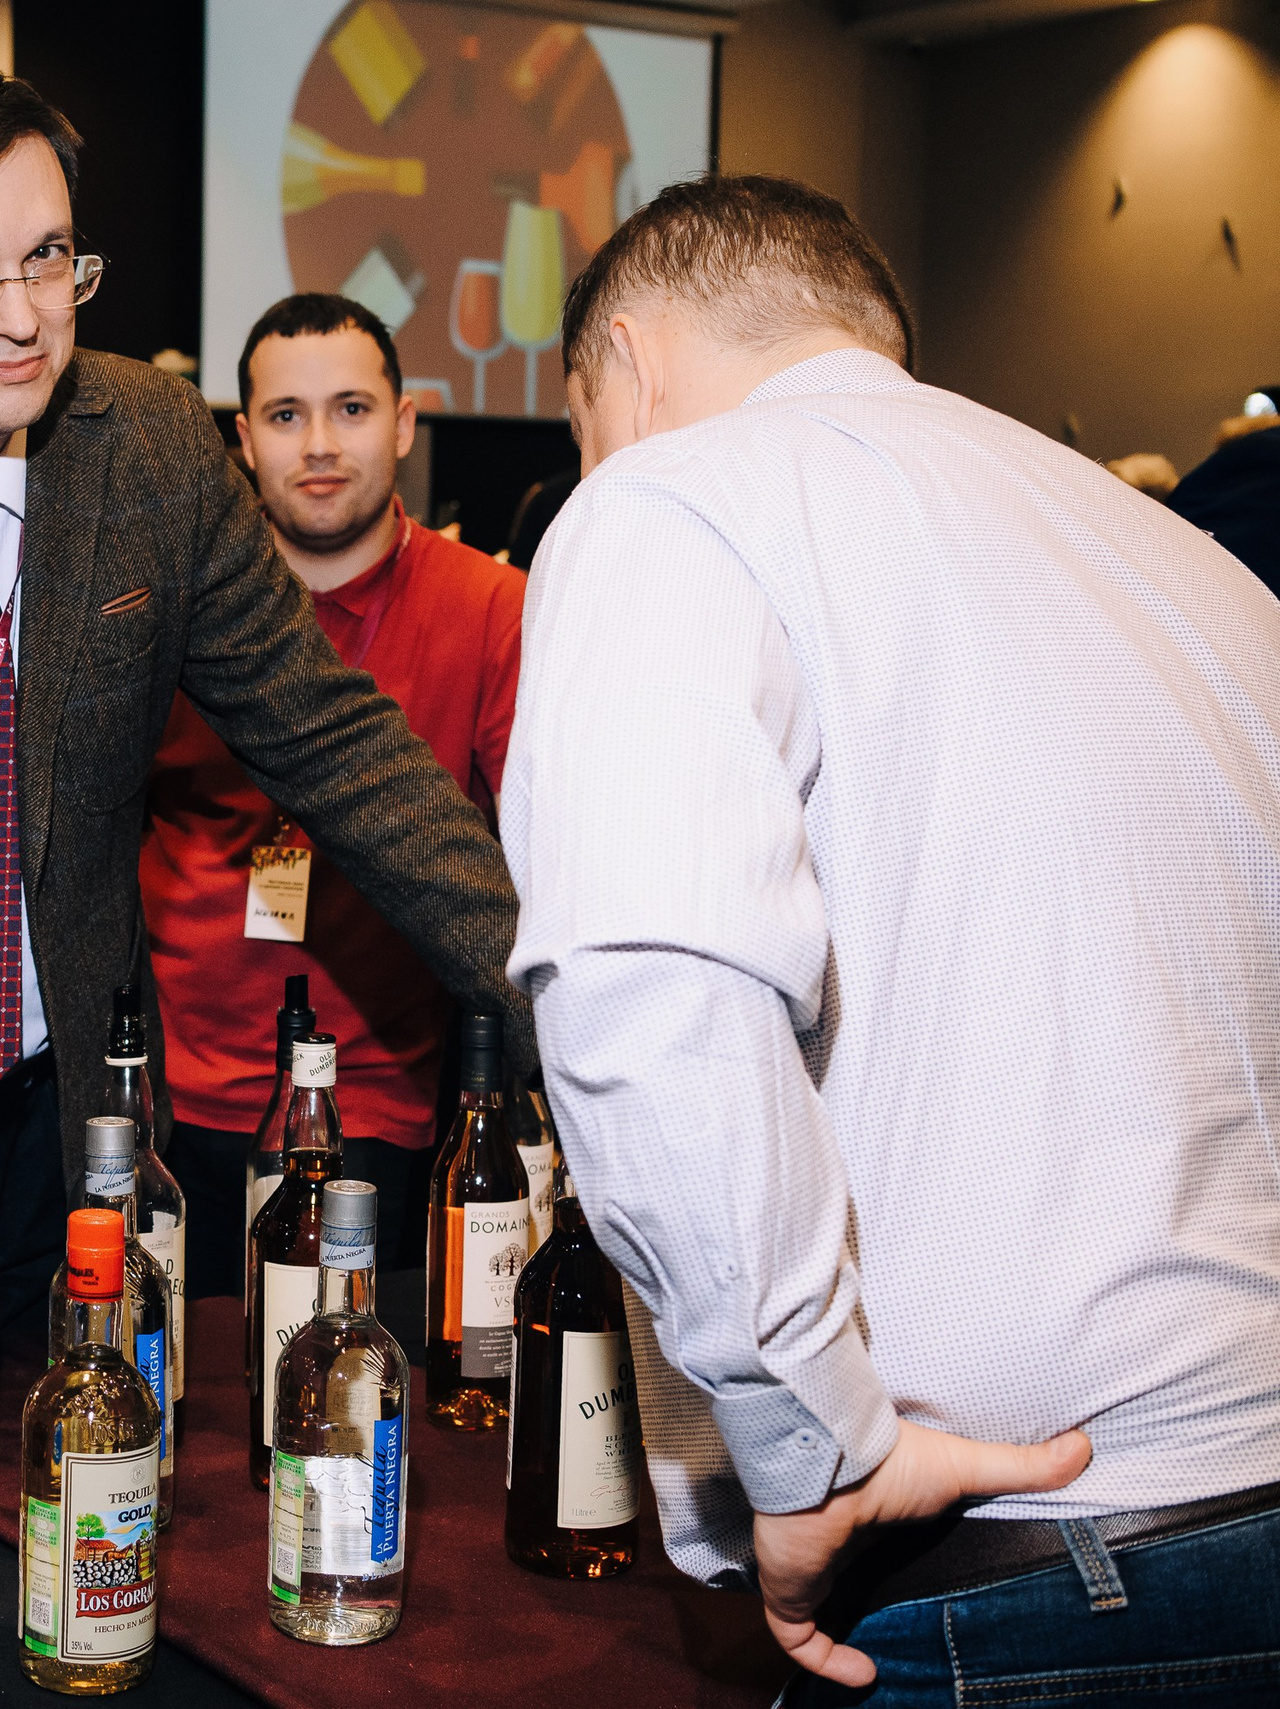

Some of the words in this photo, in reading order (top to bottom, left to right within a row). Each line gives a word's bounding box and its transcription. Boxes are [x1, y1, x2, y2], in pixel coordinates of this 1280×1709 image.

[319, 1051, 332, 1063] OLD
[471, 1211, 510, 1219] GRANDS
[470, 1217, 530, 1234] DOMAIN
[325, 1253, 346, 1261] PUERTA
[346, 1248, 367, 1259] NEGRA
[149, 1338, 160, 1393] NEGRA
[578, 1381, 635, 1420] DUMB
[386, 1424, 397, 1484] NEGRA
[108, 1482, 157, 1504] TEQUILA
[118, 1504, 152, 1523] GOLD
[383, 1489, 395, 1552] PUERTA
[375, 1542, 383, 1555] LA
[113, 1580, 156, 1609] CORRAL
[94, 1623, 125, 1633] HECHO
[127, 1619, 137, 1629] EN
[71, 1641, 82, 1651] 35%
